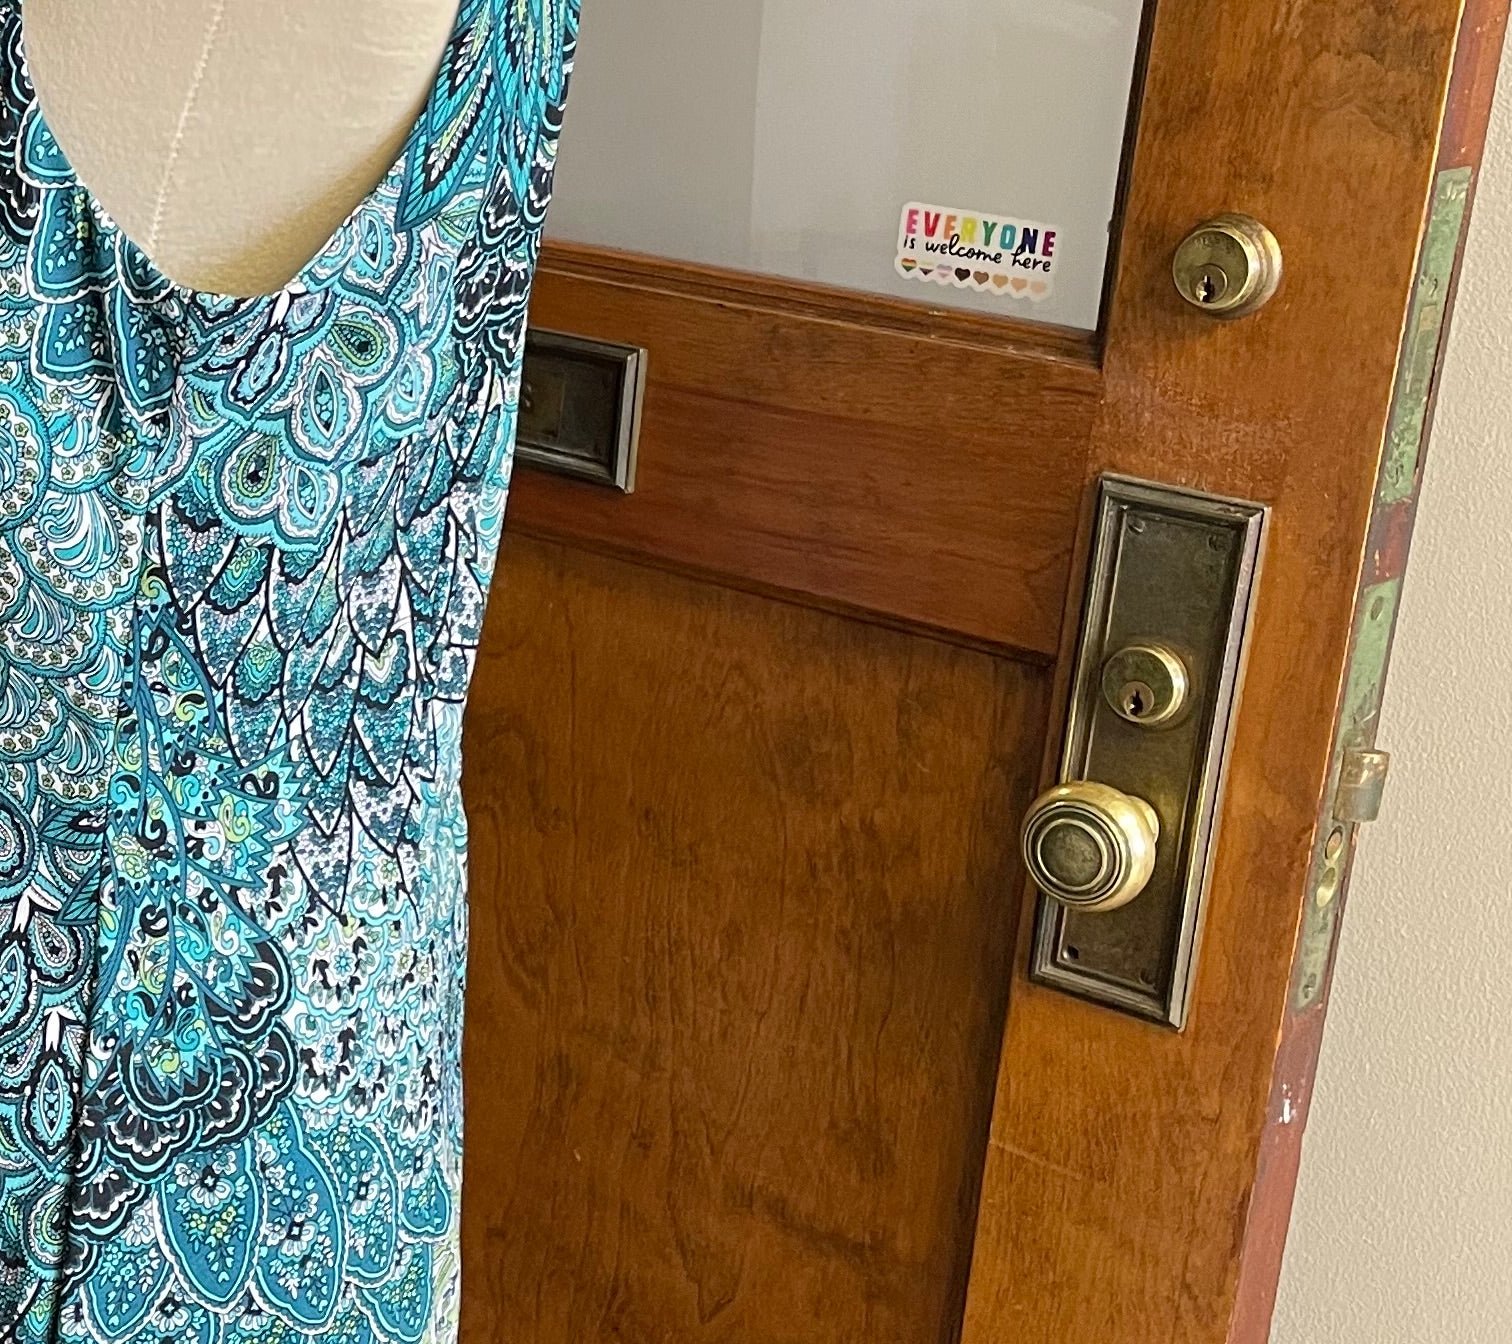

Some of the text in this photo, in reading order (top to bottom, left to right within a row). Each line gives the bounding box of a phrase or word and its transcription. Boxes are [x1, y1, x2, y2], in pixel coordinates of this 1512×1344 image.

[903, 234, 1051, 273] is welcome here
[905, 209, 1057, 257] EVERYONE
